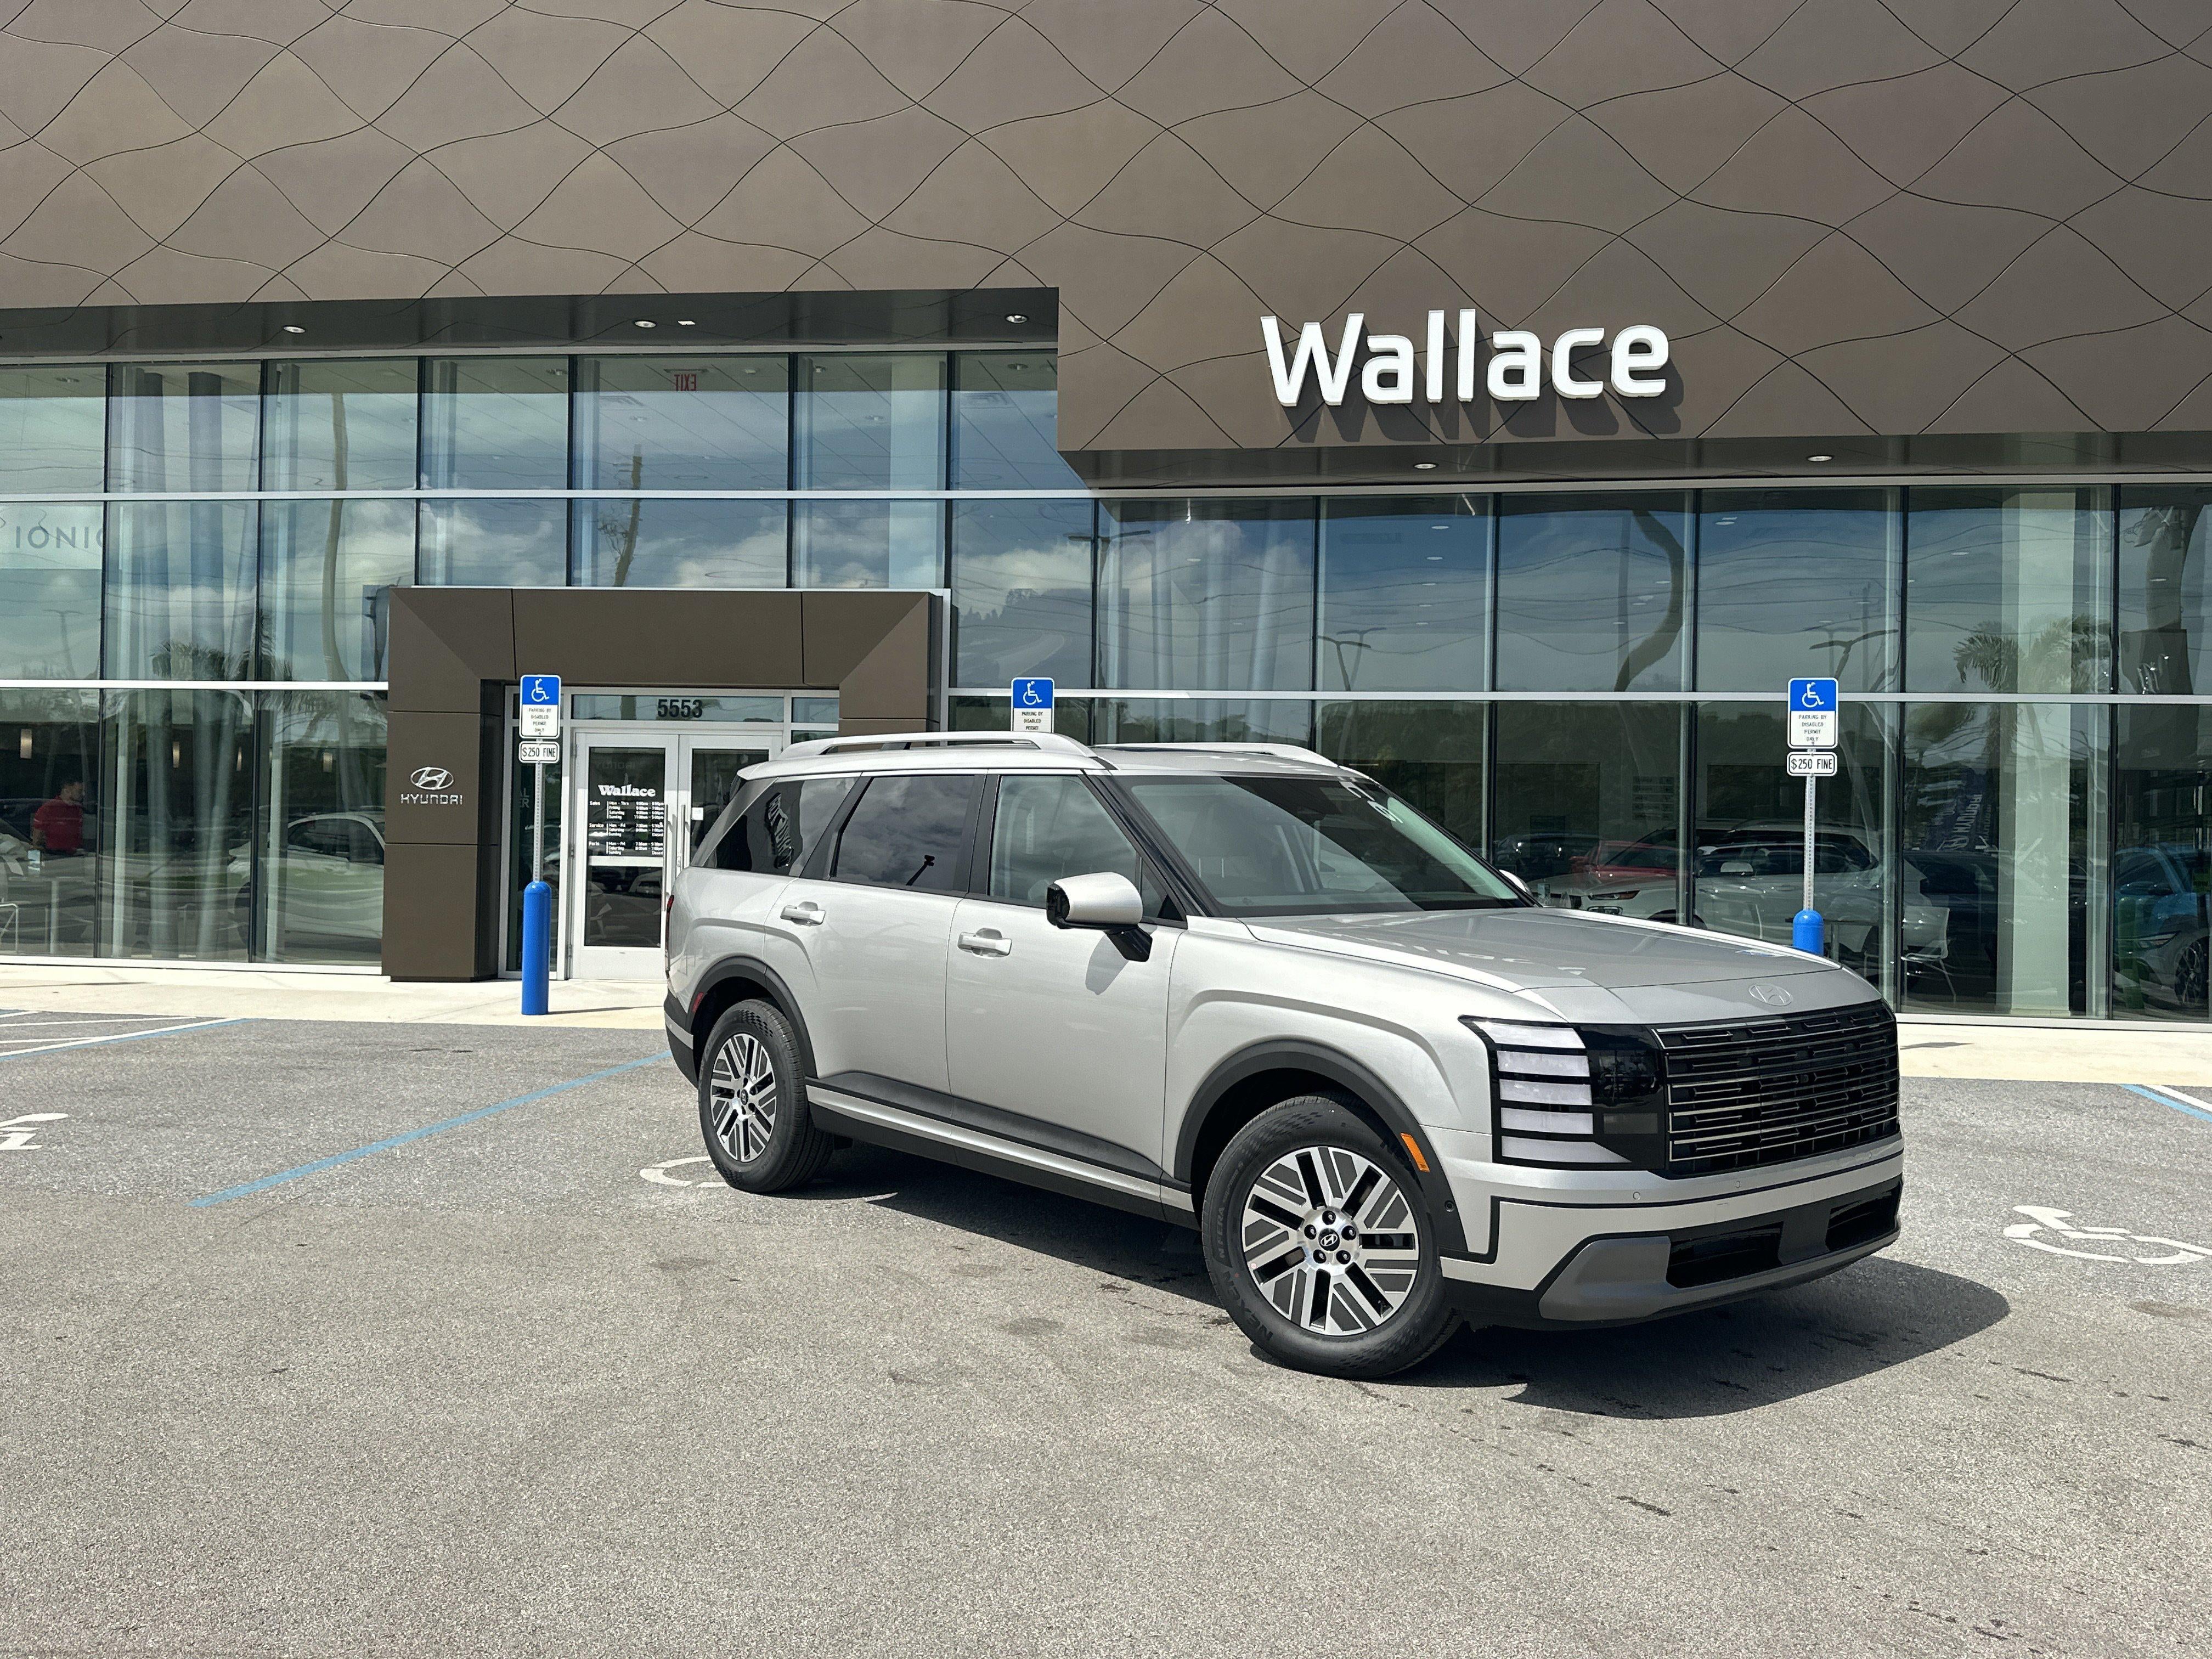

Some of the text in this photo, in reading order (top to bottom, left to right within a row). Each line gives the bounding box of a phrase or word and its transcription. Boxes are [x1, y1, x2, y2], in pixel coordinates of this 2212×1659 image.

[1260, 308, 1670, 407] Wallace
[658, 699, 703, 718] 5553
[522, 747, 556, 757] $250 FINE
[1791, 758, 1832, 770] $250 FINE
[597, 783, 656, 797] Wallace
[400, 793, 462, 805] HYUNDAI
